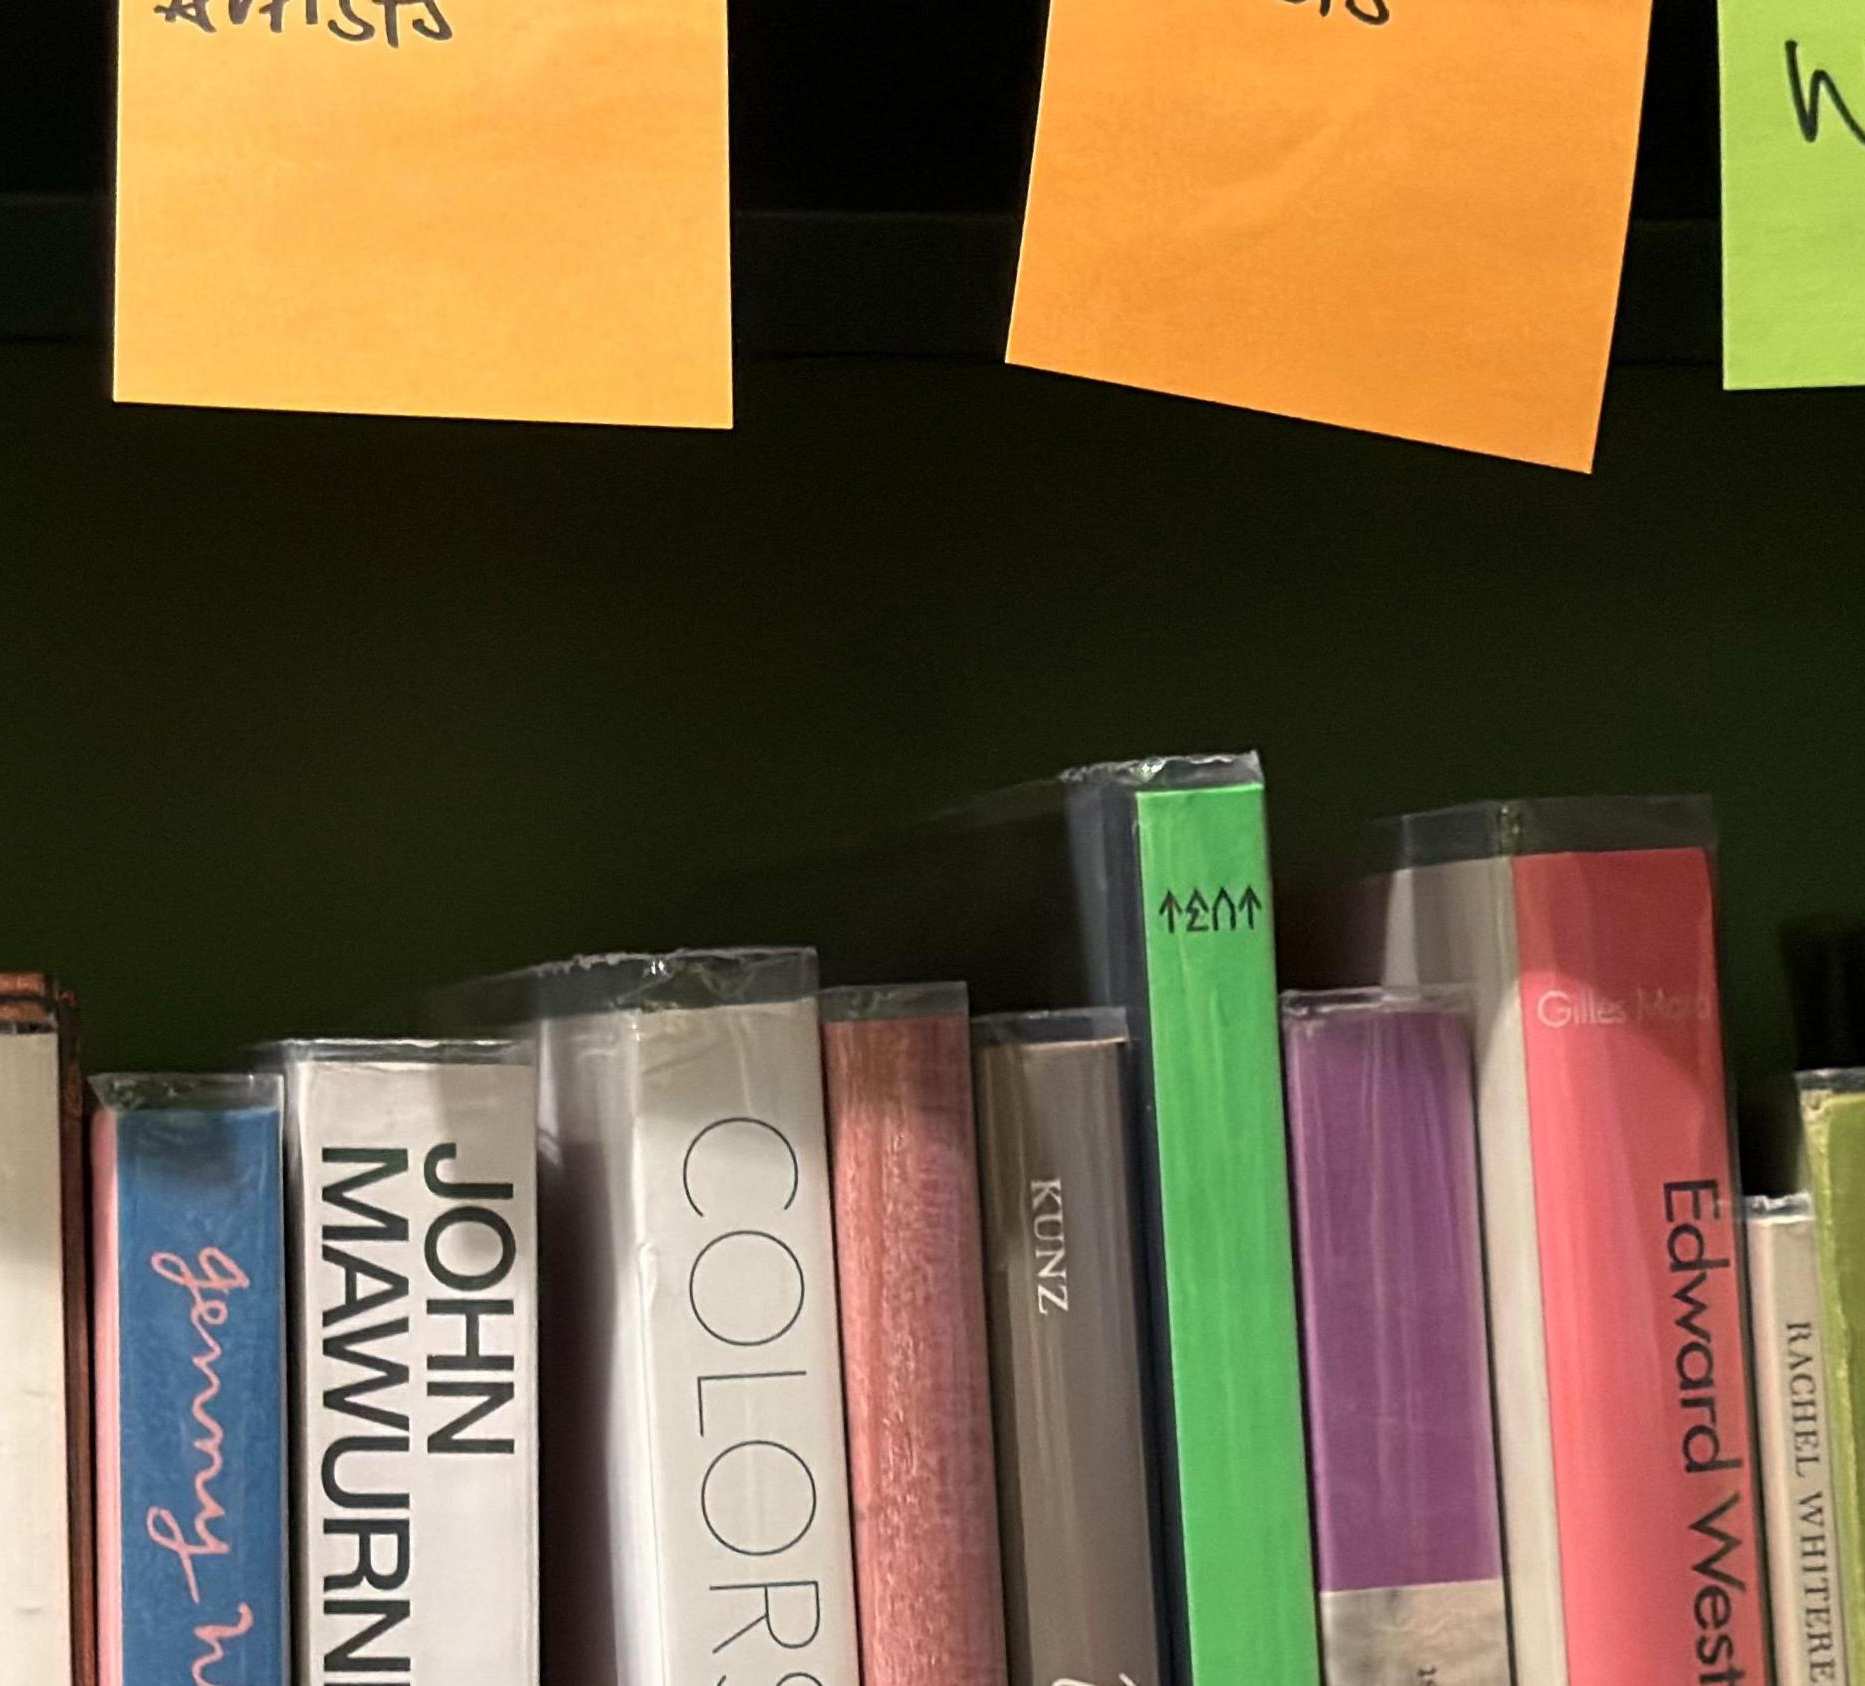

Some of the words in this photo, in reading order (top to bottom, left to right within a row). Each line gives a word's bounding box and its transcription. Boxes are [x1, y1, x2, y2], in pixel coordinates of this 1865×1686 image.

[423, 1139, 519, 1457] JOHN
[1029, 1175, 1072, 1318] KUNZ
[1660, 1178, 1743, 1475] Edward
[1783, 1320, 1823, 1480] RACHEL
